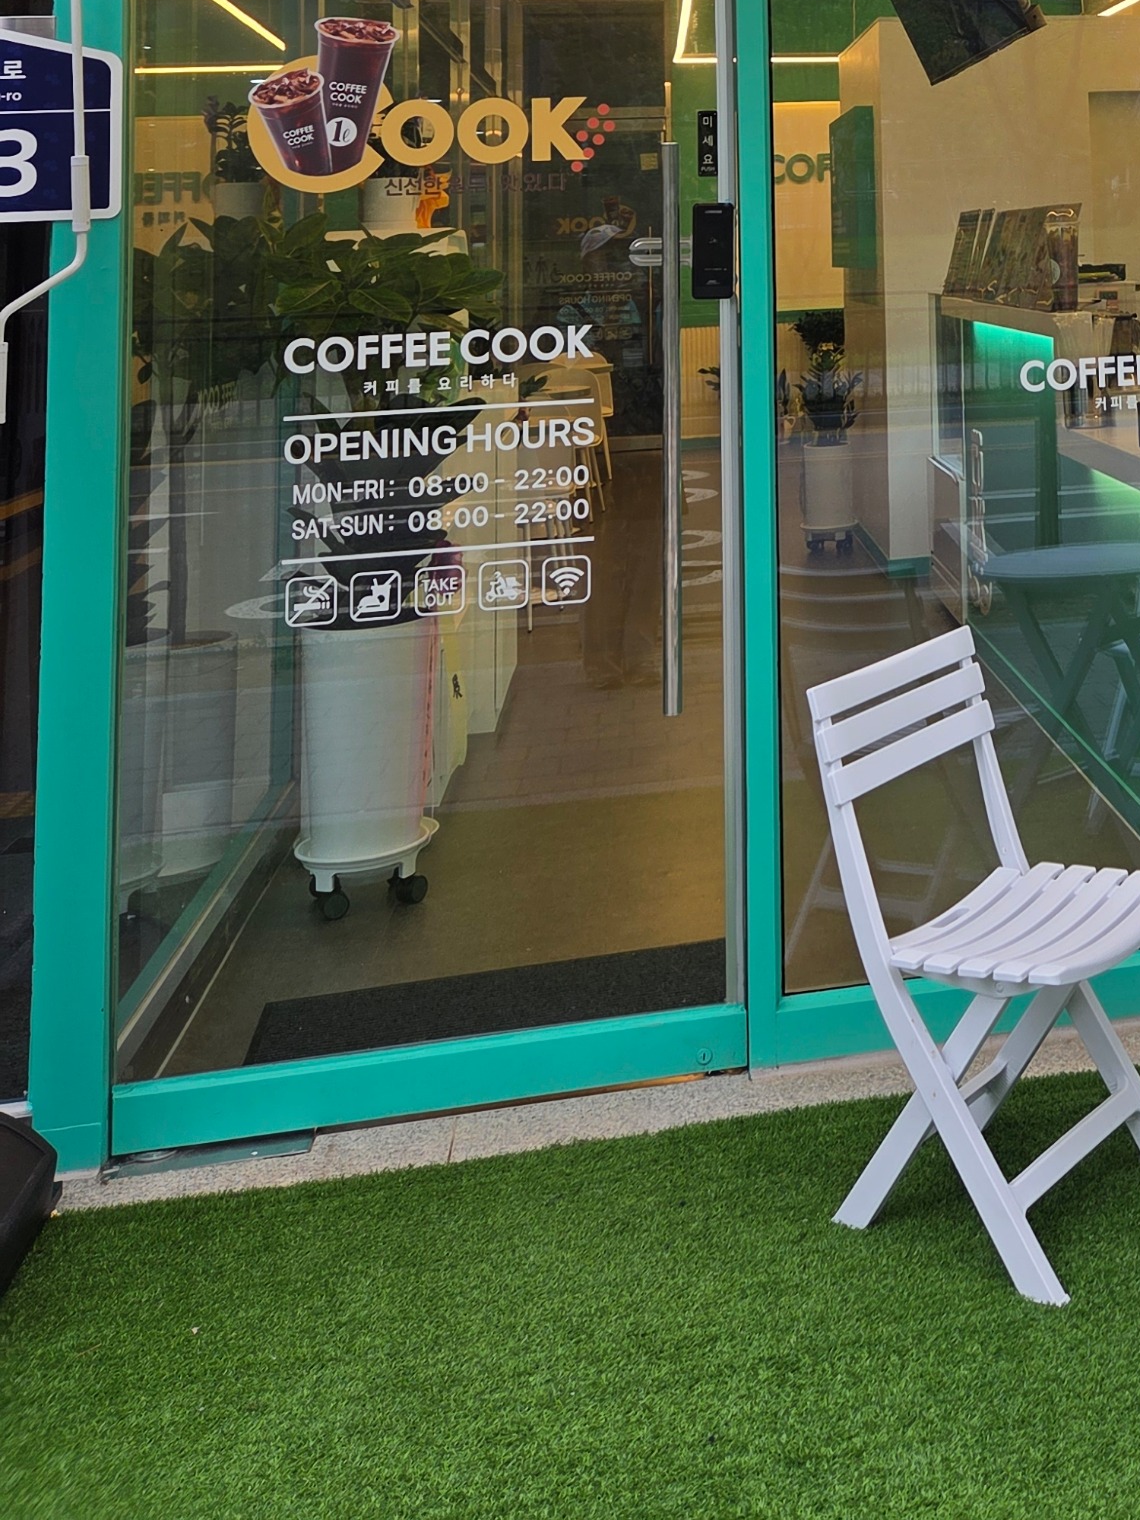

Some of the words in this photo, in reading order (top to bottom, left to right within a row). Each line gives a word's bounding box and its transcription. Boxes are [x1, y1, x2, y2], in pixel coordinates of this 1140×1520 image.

[0, 91, 22, 102] -ro
[329, 81, 368, 95] COFFEE
[330, 92, 363, 105] COOK
[283, 124, 315, 139] COFFEE
[287, 133, 315, 146] COOK
[384, 175, 443, 198] 신선한
[283, 330, 451, 375] COFFEE
[459, 324, 594, 366] COOK
[363, 378, 422, 396] 커피를
[437, 371, 519, 391] 요리하다
[1094, 394, 1138, 412] 커피를
[283, 425, 457, 466] OPENING
[465, 416, 595, 454] HOURS
[407, 471, 489, 499] 08:00
[513, 464, 589, 492] 22:00
[407, 505, 489, 533] 08:00
[513, 498, 589, 526] 22:00
[420, 576, 458, 593] TAKE
[425, 592, 455, 608] OUT
